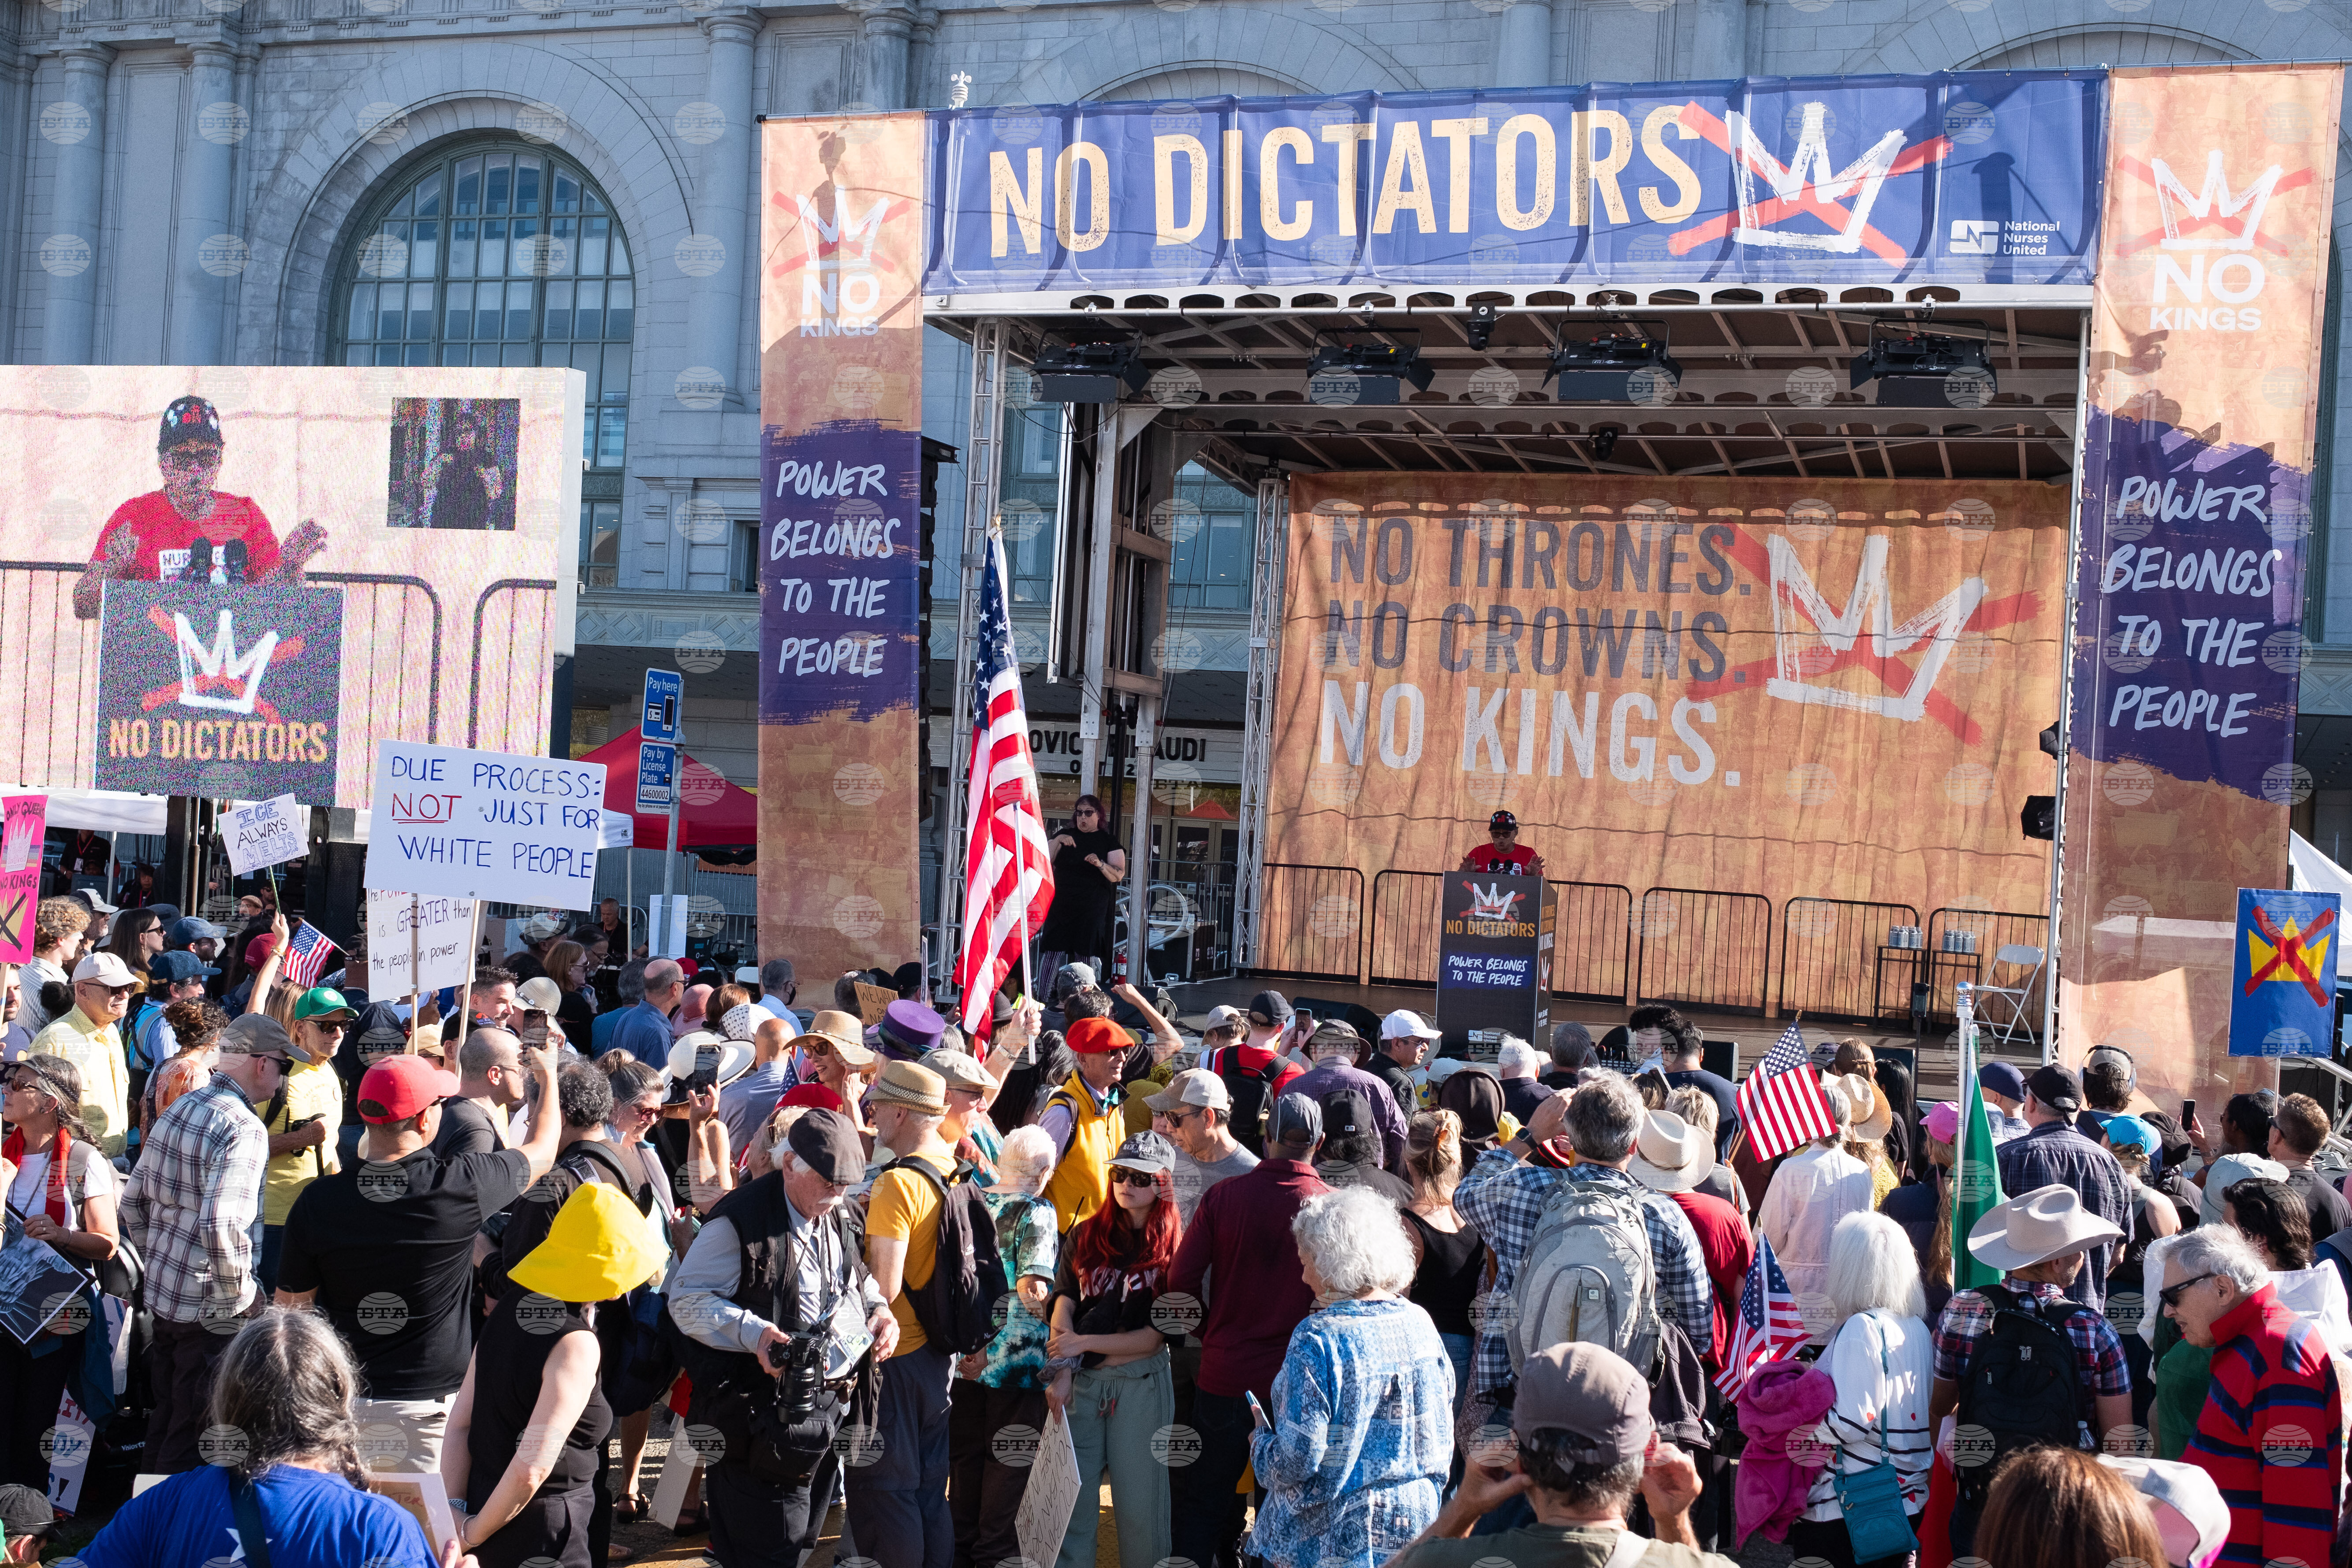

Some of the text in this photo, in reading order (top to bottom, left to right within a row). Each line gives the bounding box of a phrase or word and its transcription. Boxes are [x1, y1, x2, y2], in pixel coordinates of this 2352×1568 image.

[989, 105, 1701, 258] NO DICTATORS
[2004, 233, 2048, 243] Nurses
[2005, 220, 2060, 232] National
[2003, 244, 2046, 255] United
[802, 272, 880, 314] NO
[2151, 253, 2265, 305] NO
[800, 316, 879, 338] KINGS
[2150, 307, 2262, 331] KINGS
[776, 460, 887, 499] POWER
[2116, 476, 2266, 523] POWER
[770, 518, 901, 561] BELONGS
[1330, 518, 1751, 596] NO THRONES.
[2103, 543, 2282, 597] BELONGS
[780, 576, 890, 618] TO THE
[779, 637, 888, 677] PEOPLE
[1328, 600, 1746, 683] NO CROWNS.
[2118, 615, 2264, 667] TO THE
[649, 677, 677, 693] Pay here
[2109, 684, 2257, 738] PEOPLE
[108, 719, 328, 763] NO DICTATORS
[1320, 680, 1741, 787] NO KINGS.
[643, 760, 666, 772] License
[644, 747, 665, 761] Pay by
[391, 756, 601, 798] DUE PROCESS:
[641, 789, 668, 800] 44600002
[642, 772, 658, 784] Plate
[7, 801, 45, 820] ONLY QUEENS
[236, 801, 279, 830] ICE
[391, 793, 600, 831] NOT JUST FOR
[237, 818, 288, 849] ALWAYS
[242, 831, 299, 868] MELTS
[398, 835, 594, 878] WHITE PEOPLE
[10, 874, 37, 889] KINGS
[378, 920, 386, 938] is
[454, 901, 471, 919] than
[1446, 920, 1535, 937] NO DICTATORS
[373, 952, 385, 971] the
[417, 946, 425, 961] in
[431, 942, 458, 965] power
[1448, 955, 1528, 972] POWER BELONGS
[857, 985, 876, 1003] WE
[1452, 969, 1523, 986] TO THE PEOPLE
[1055, 1427, 1071, 1483] YOU
[1041, 1469, 1057, 1529] BAN
[1045, 1466, 1077, 1566] YOU BAN
